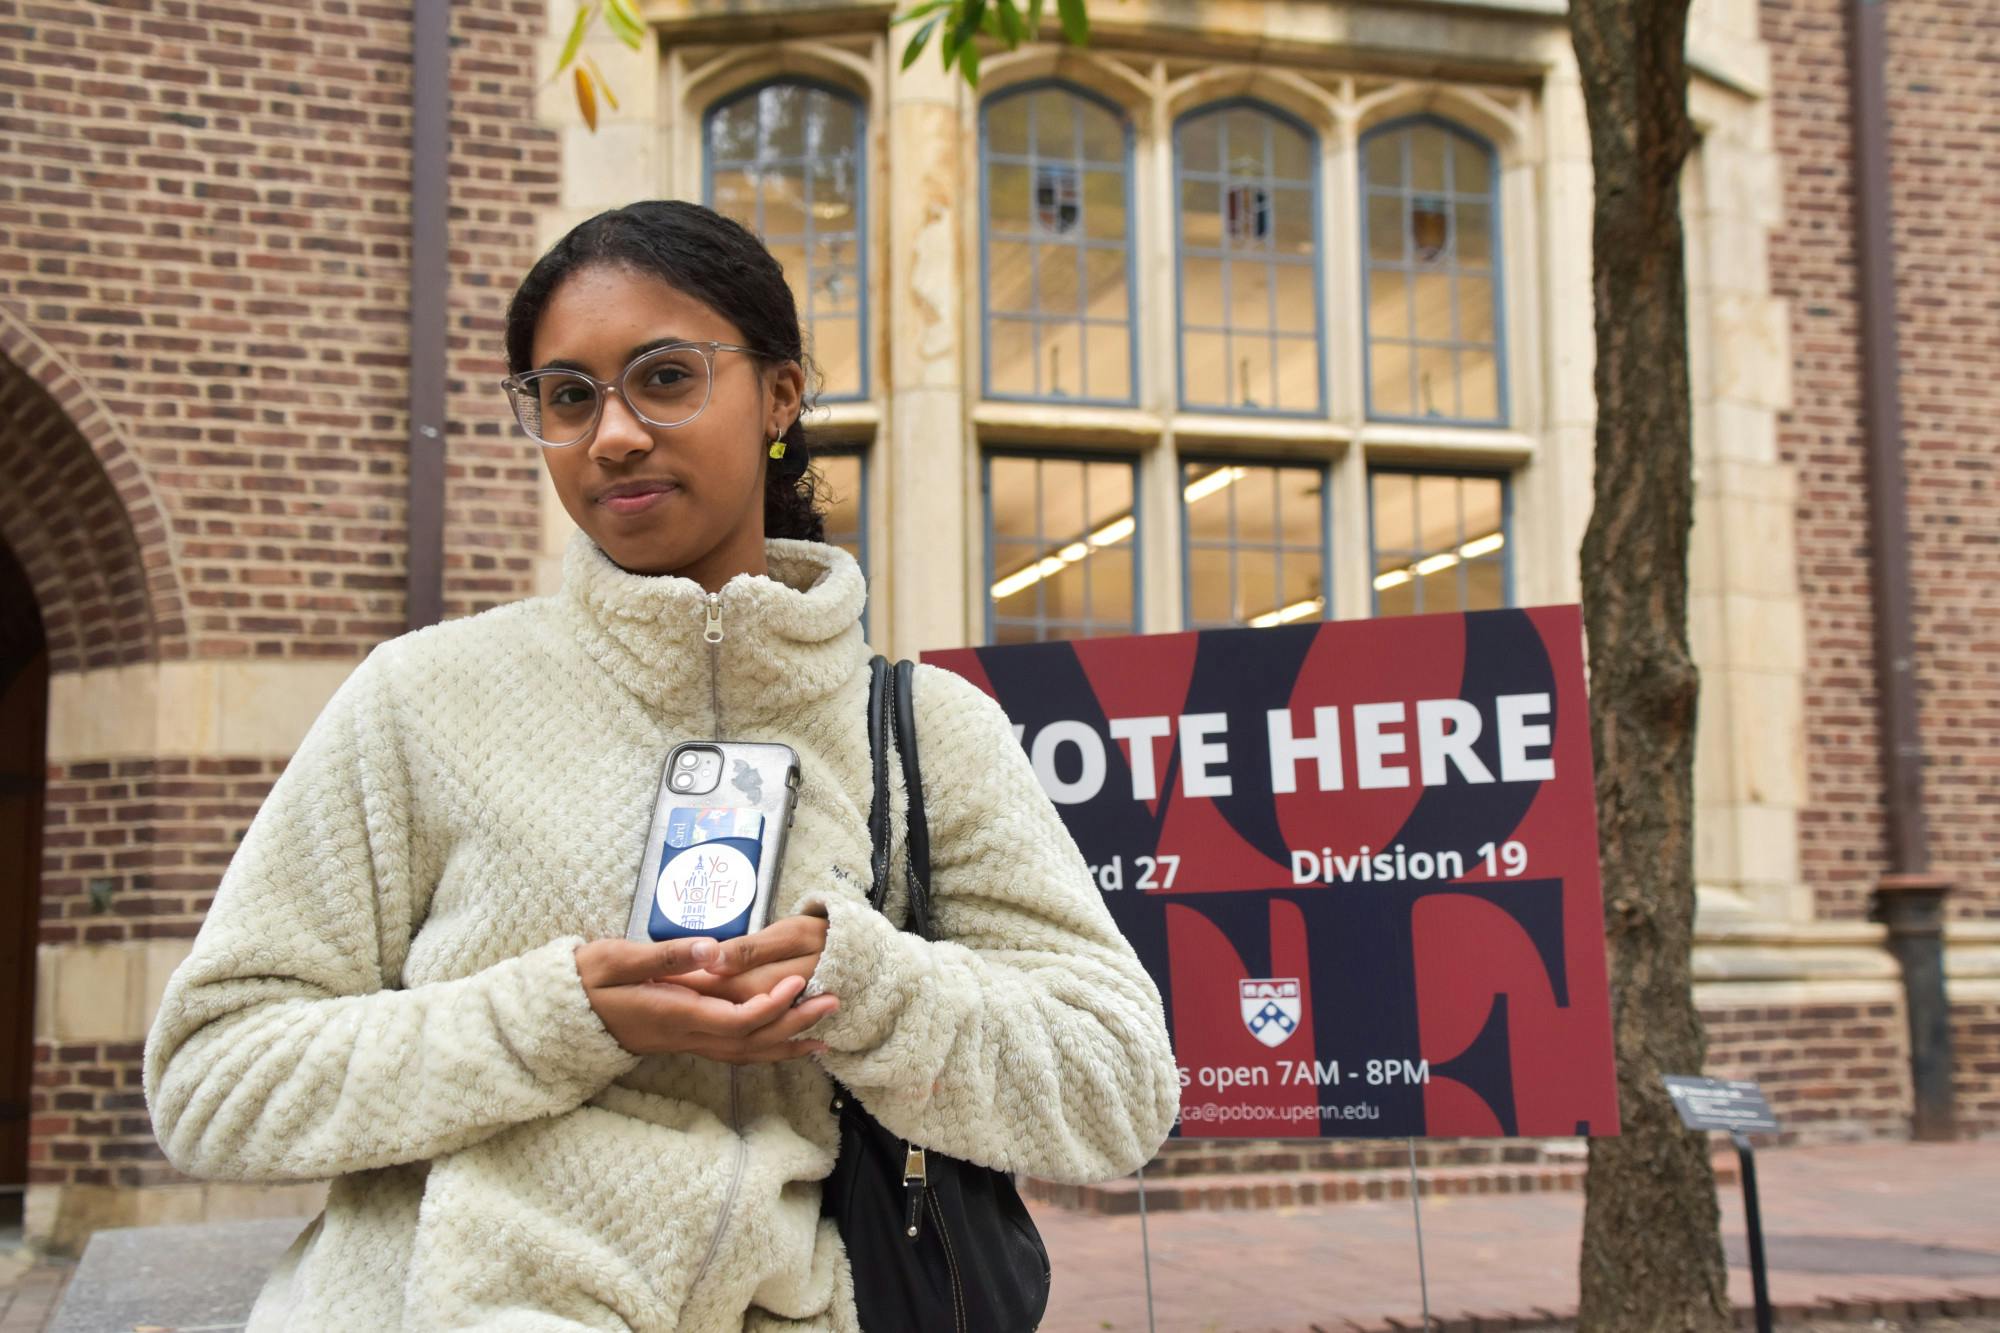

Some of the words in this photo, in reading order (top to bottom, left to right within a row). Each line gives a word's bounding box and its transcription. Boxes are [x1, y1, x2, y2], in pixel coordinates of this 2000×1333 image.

[1012, 712, 1233, 805] OTE
[1267, 692, 1556, 794] HERE
[1134, 854, 1181, 890] 27
[1290, 843, 1464, 885] Division
[1477, 840, 1529, 878] 19
[1198, 1065, 1269, 1093] open
[1275, 1060, 1340, 1086] 7AM
[1365, 1059, 1430, 1086] 8PM
